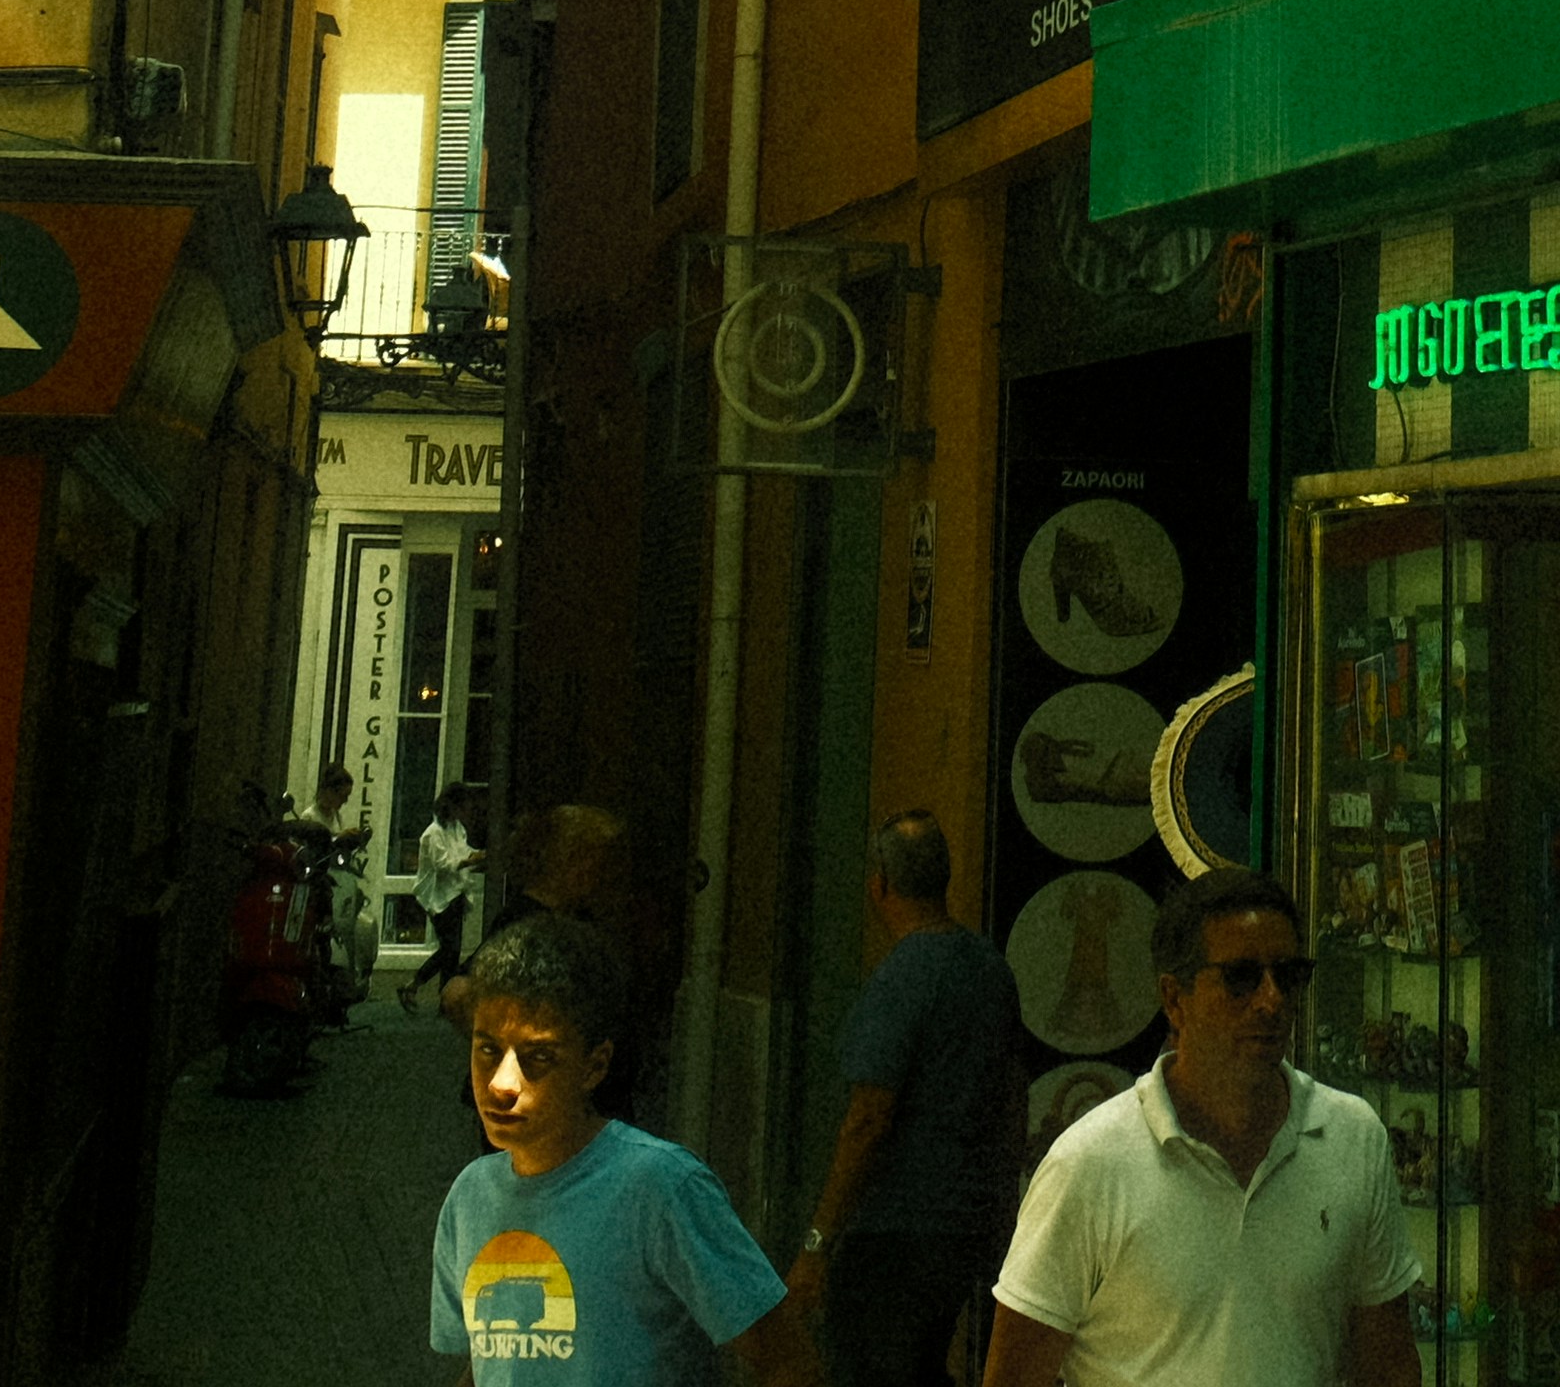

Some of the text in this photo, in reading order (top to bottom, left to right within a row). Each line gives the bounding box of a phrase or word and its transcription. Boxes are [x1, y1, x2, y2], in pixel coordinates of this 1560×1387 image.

[404, 433, 504, 487] TRAVE
[1060, 470, 1145, 490] ZAPAORI
[369, 563, 394, 702] POSTER
[354, 715, 381, 878] GALLEY
